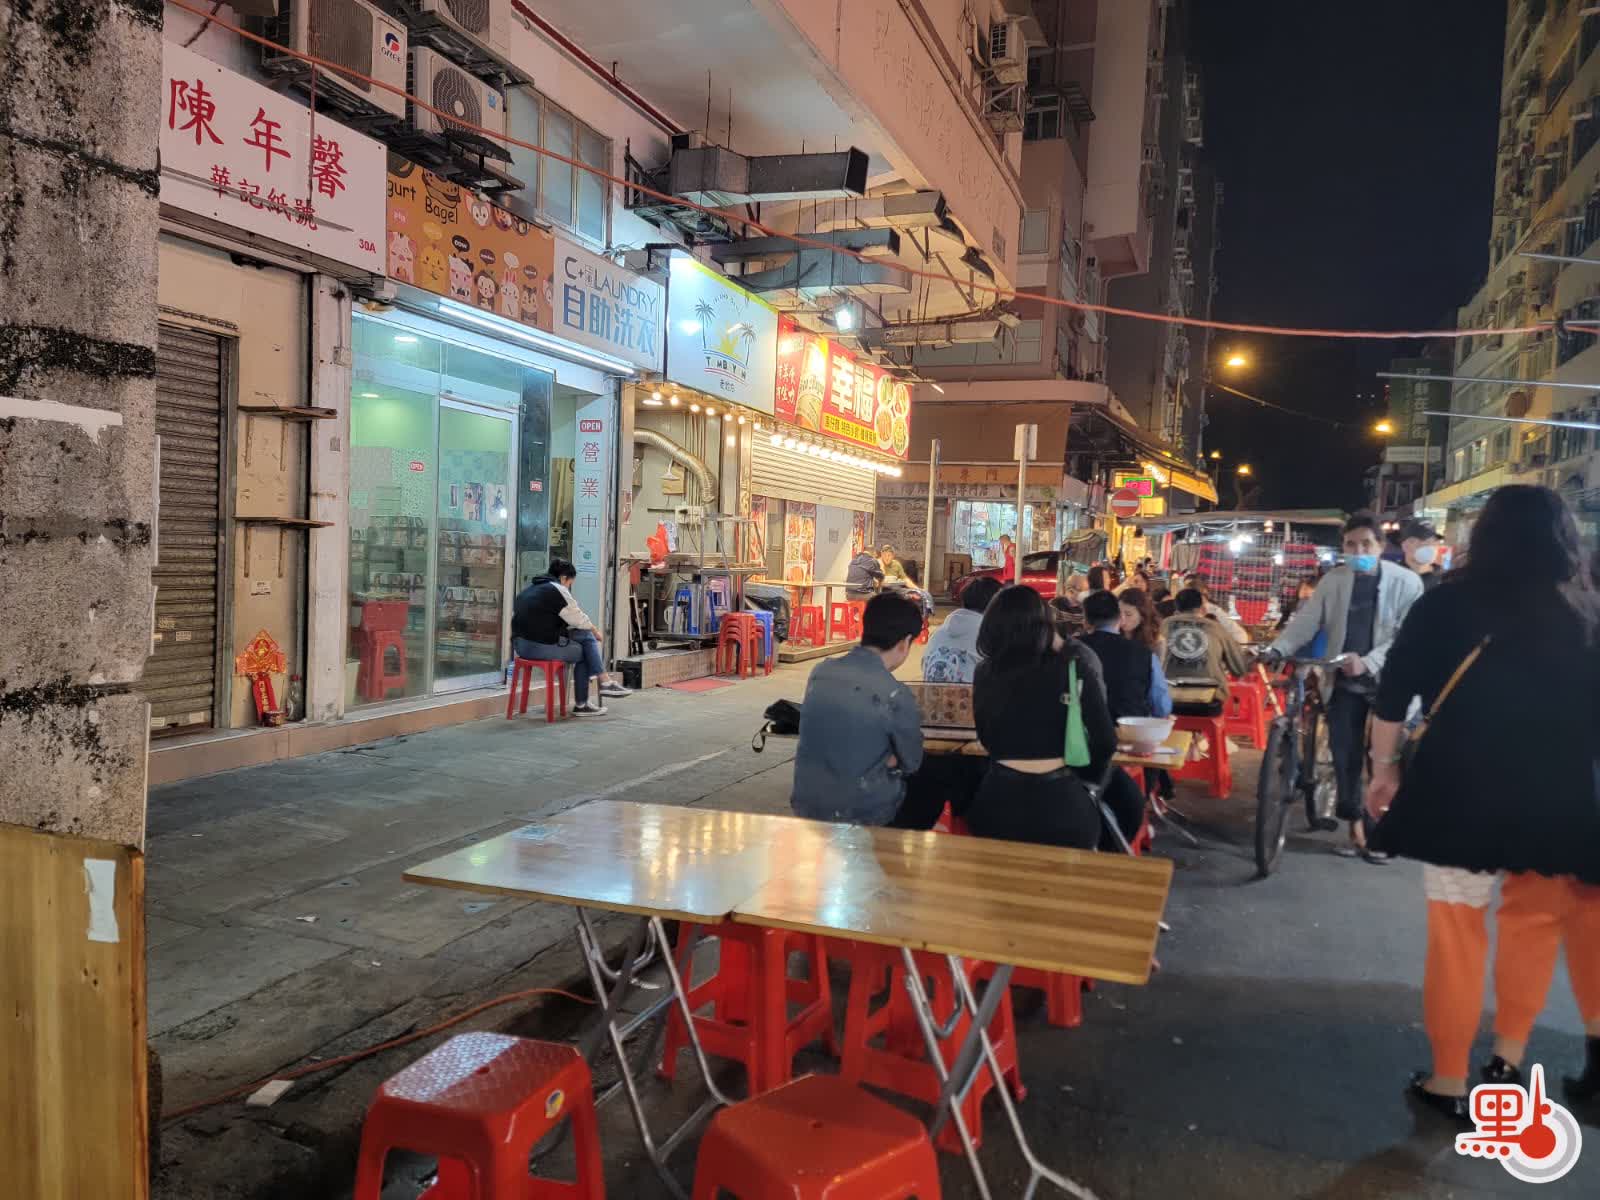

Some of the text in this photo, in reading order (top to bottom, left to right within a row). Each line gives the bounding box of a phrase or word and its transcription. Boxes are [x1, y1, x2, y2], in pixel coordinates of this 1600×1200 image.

[169, 78, 349, 200] 陳年馨
[425, 195, 459, 225] Bagel
[358, 238, 377, 254] 30A
[594, 267, 657, 314] LAUNDRY
[562, 283, 656, 358] 自助洗衣
[830, 353, 875, 424] 幸福
[580, 420, 602, 432] OPEN
[581, 440, 601, 536] 營業中
